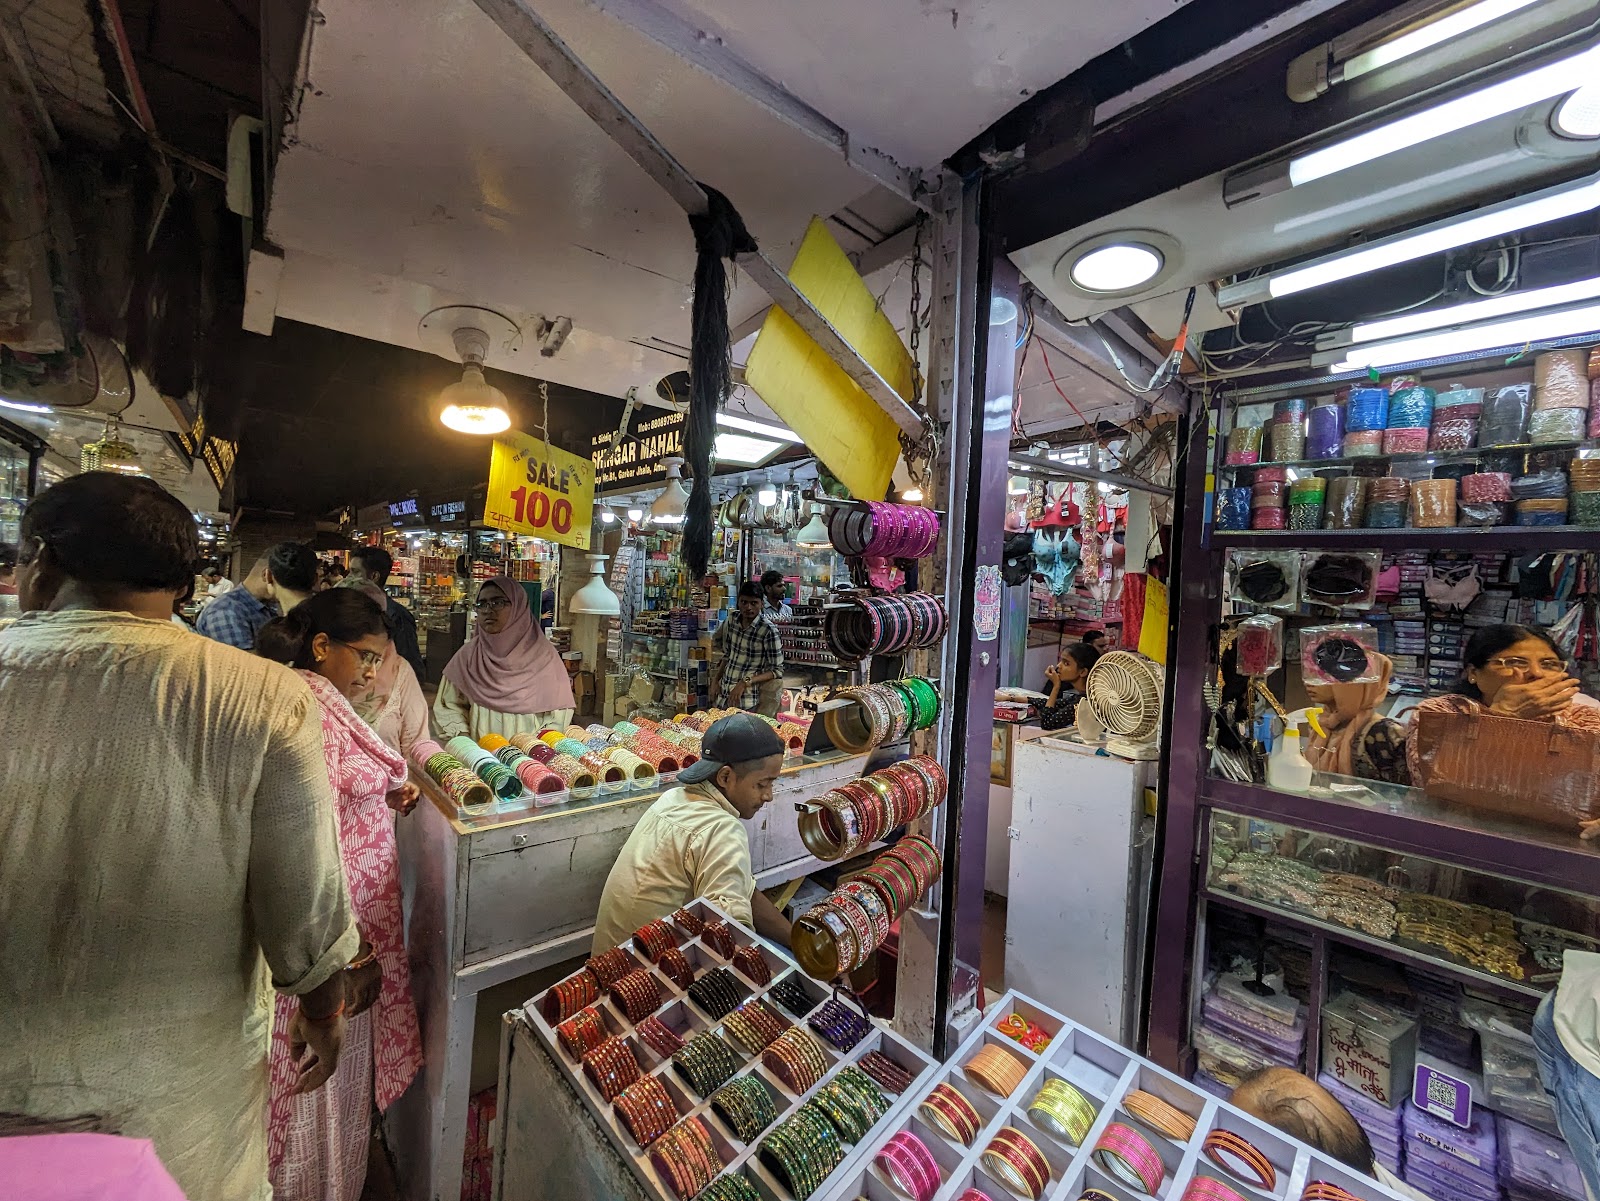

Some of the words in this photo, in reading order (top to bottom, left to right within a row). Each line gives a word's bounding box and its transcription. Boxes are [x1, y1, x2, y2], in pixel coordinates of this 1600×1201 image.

[640, 430, 683, 460] MAHAL
[526, 457, 570, 494] SALE
[510, 485, 573, 535] 100
